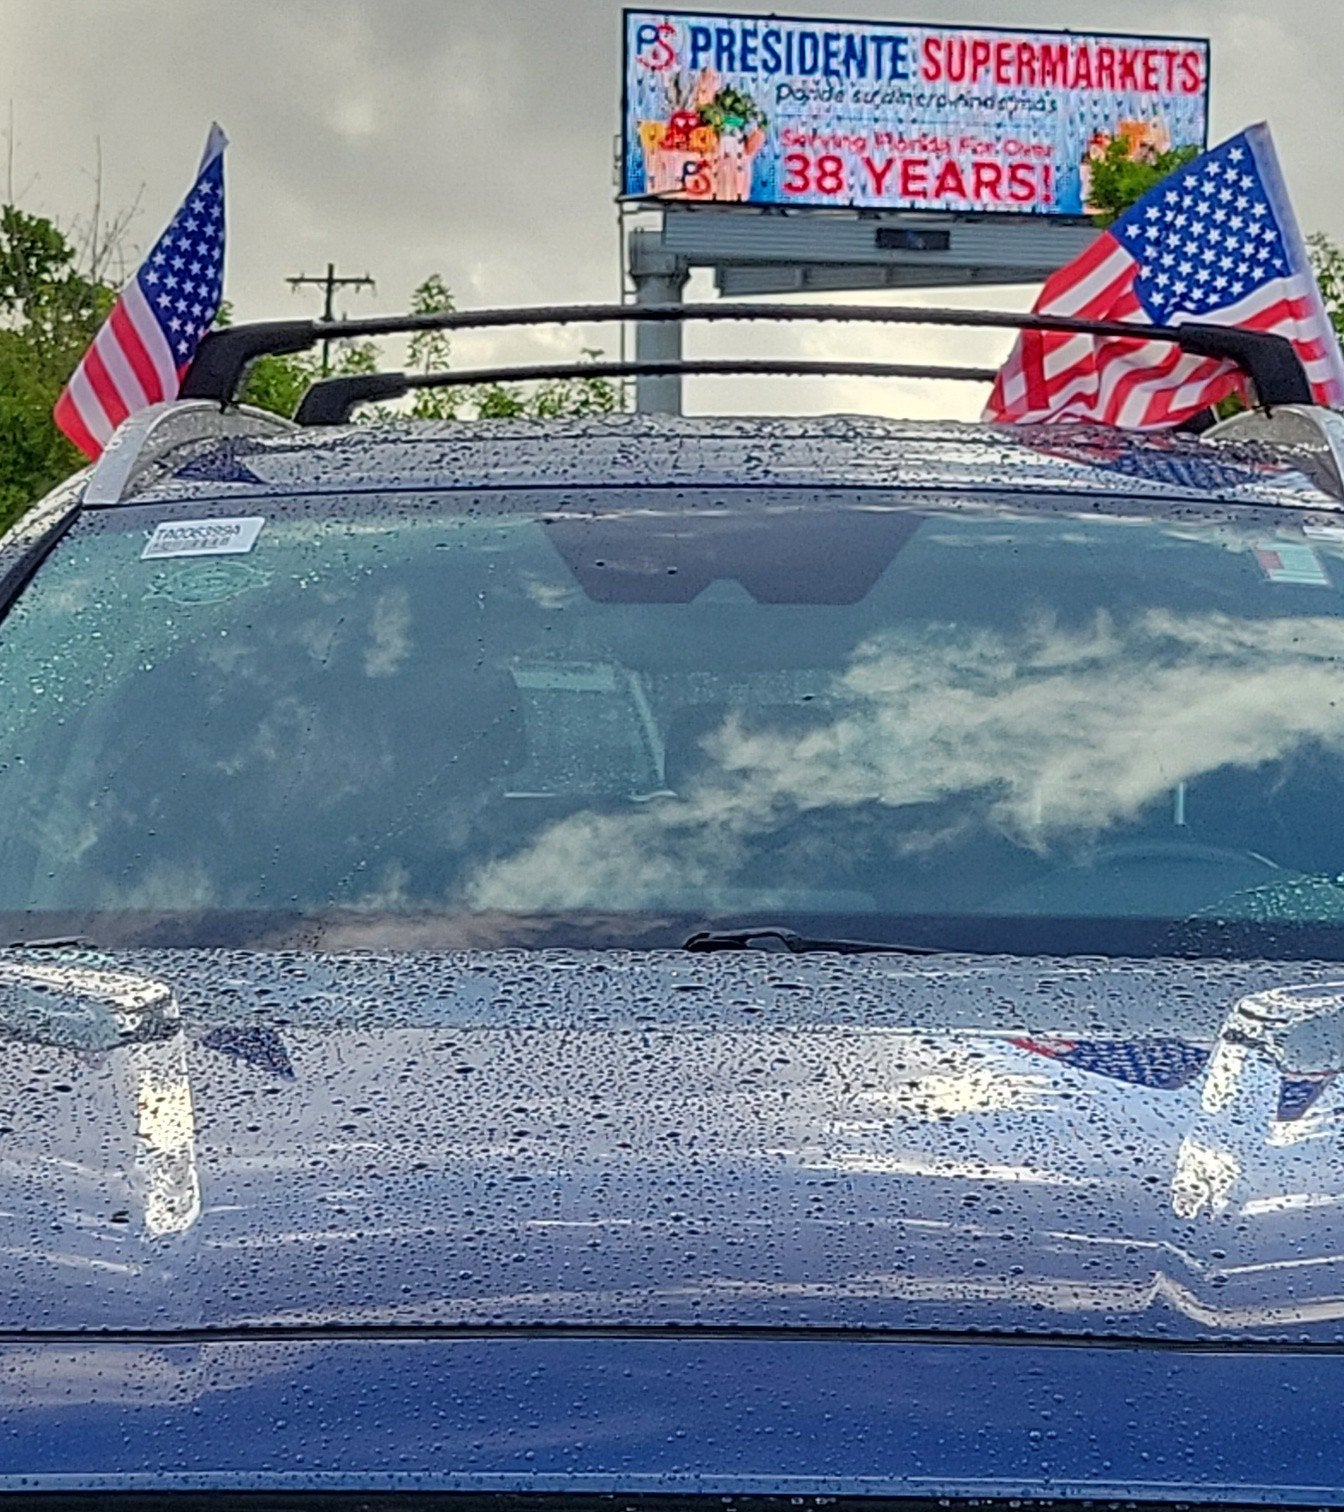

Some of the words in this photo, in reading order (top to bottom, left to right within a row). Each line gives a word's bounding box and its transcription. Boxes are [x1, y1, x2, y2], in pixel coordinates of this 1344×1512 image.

[689, 25, 909, 80] PRESIDENTE
[921, 37, 1202, 94] SUPERMARKETS
[783, 153, 844, 195] 38
[862, 157, 1053, 204] YEARS!
